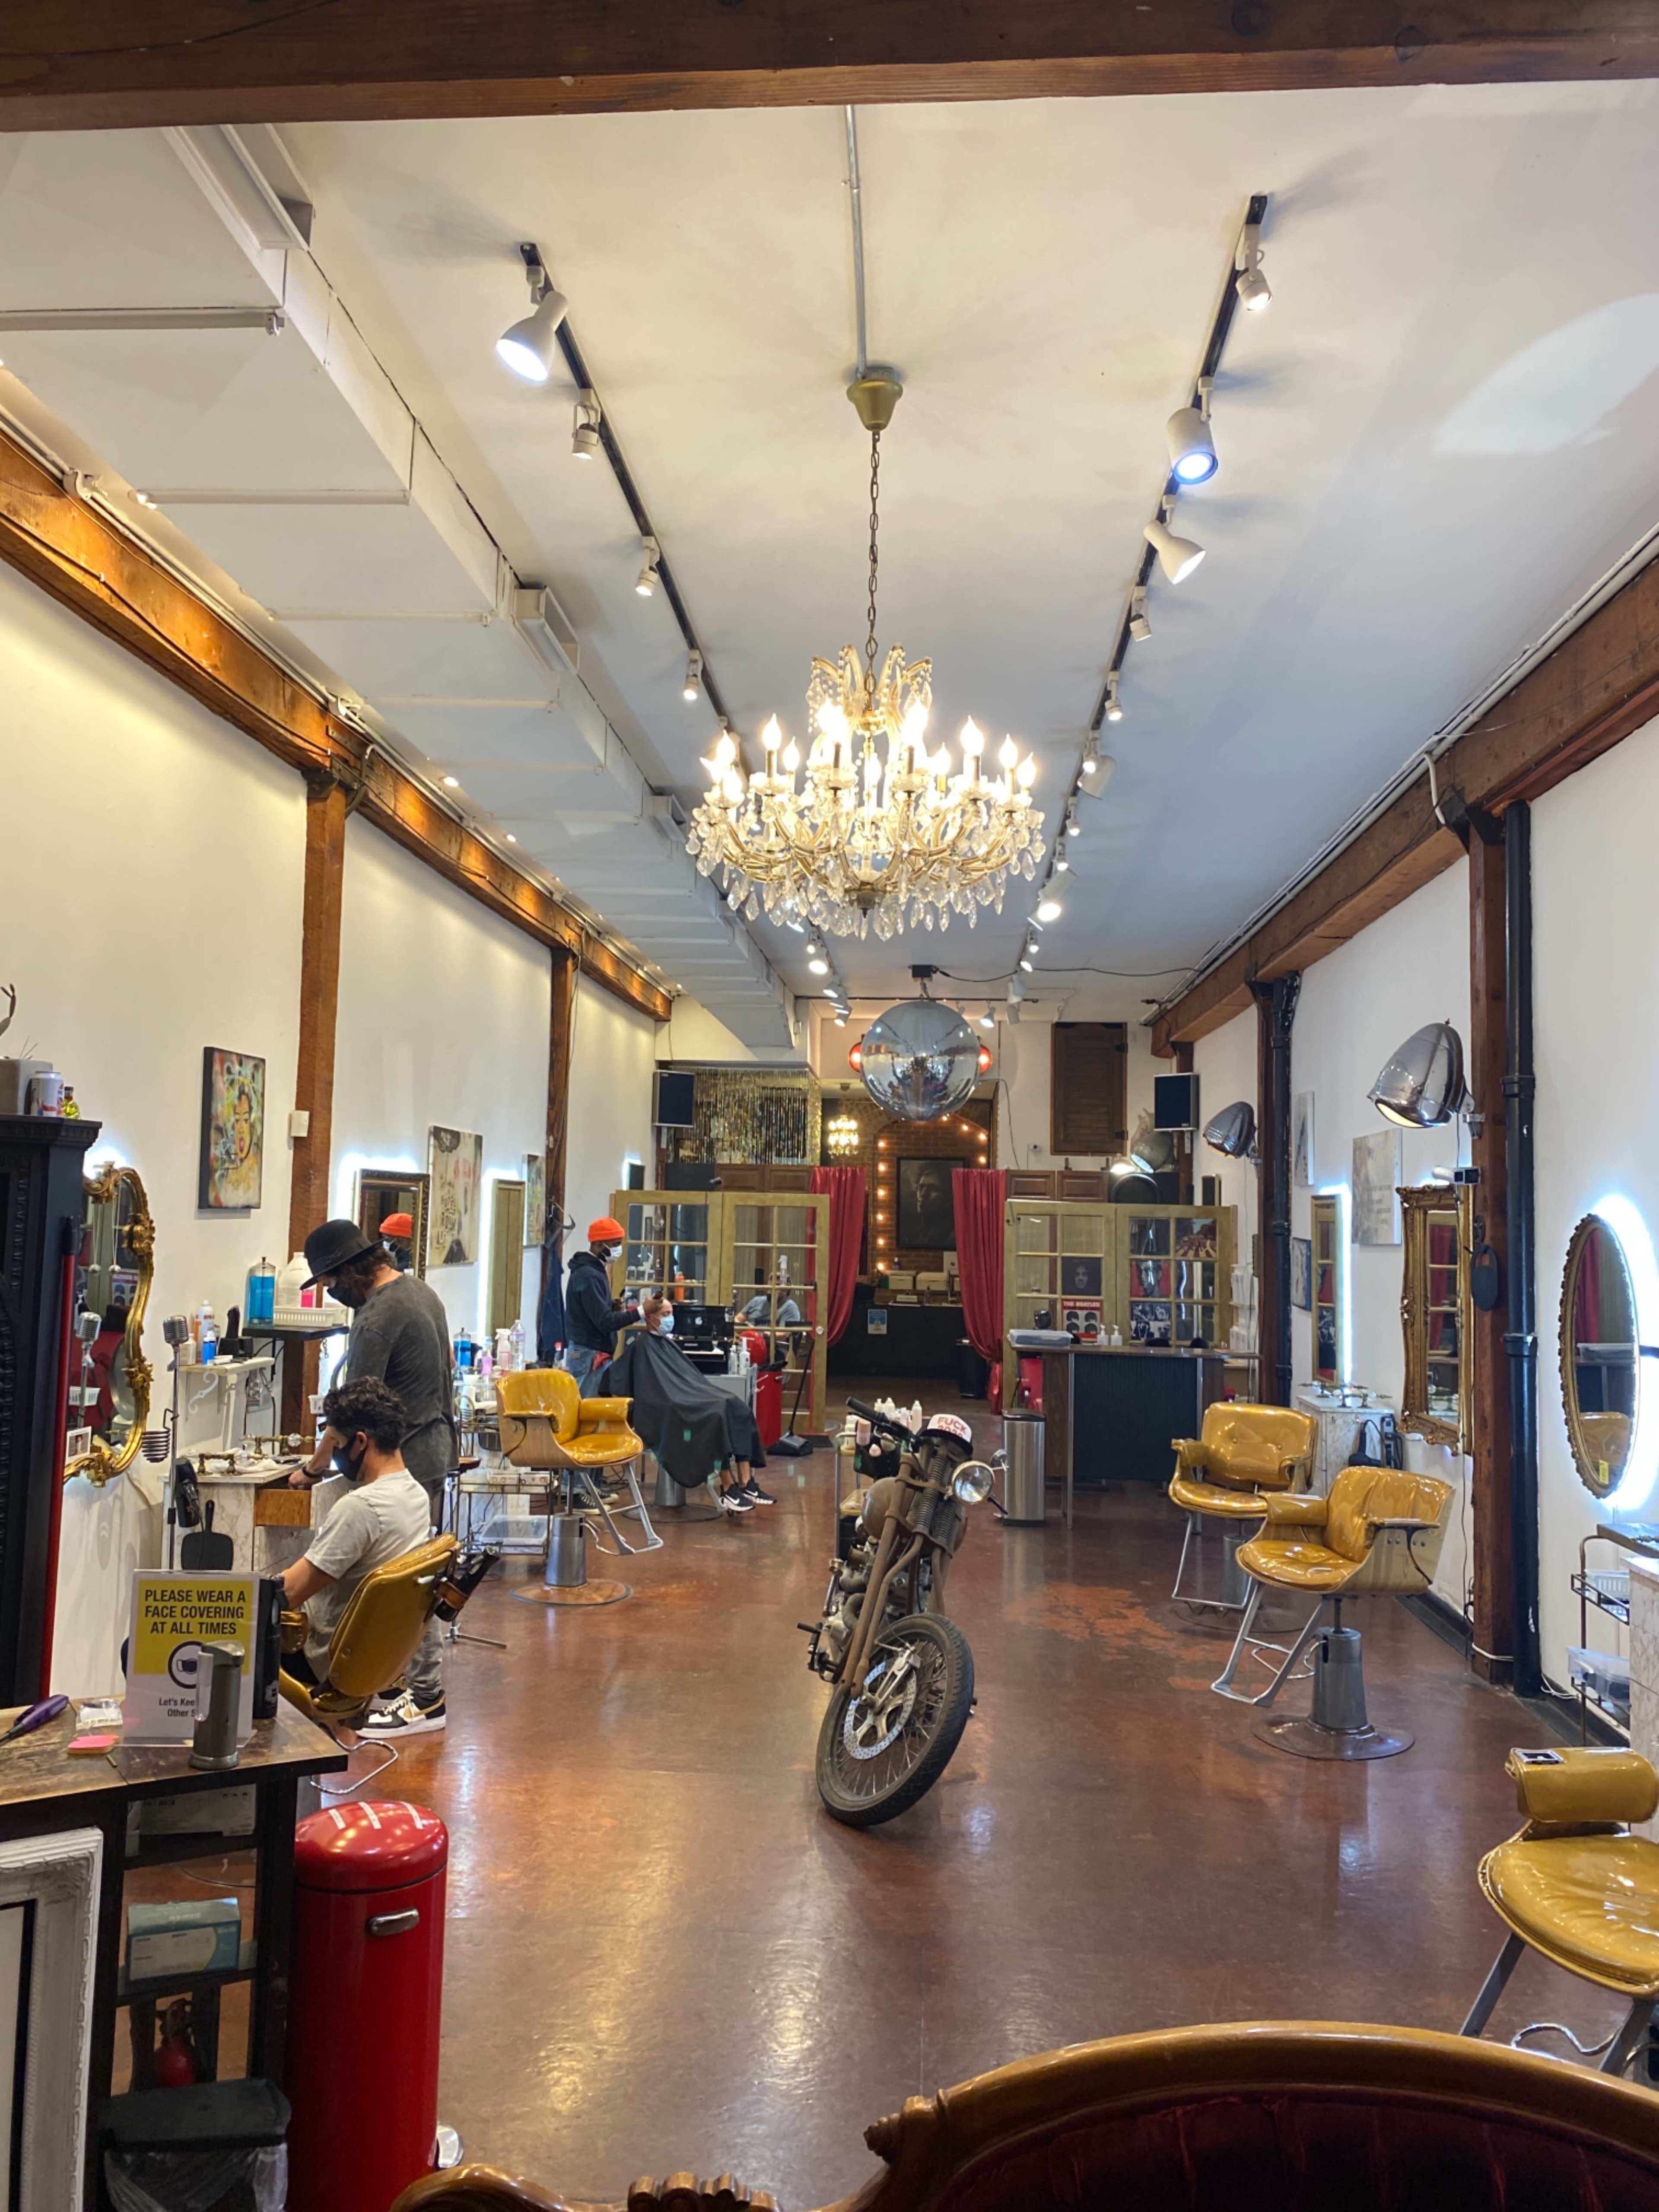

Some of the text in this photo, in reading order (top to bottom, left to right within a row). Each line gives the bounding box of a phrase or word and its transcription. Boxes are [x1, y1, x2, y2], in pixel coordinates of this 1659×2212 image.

[938, 1417, 966, 1434] FUCK
[145, 1589, 246, 1603] PLEASE WEAR A
[145, 1605, 244, 1618] FACE COVERING
[150, 1621, 236, 1634] AT ALL TIMES
[159, 1697, 195, 1706] Let's Kee
[167, 1708, 189, 1717] Other
